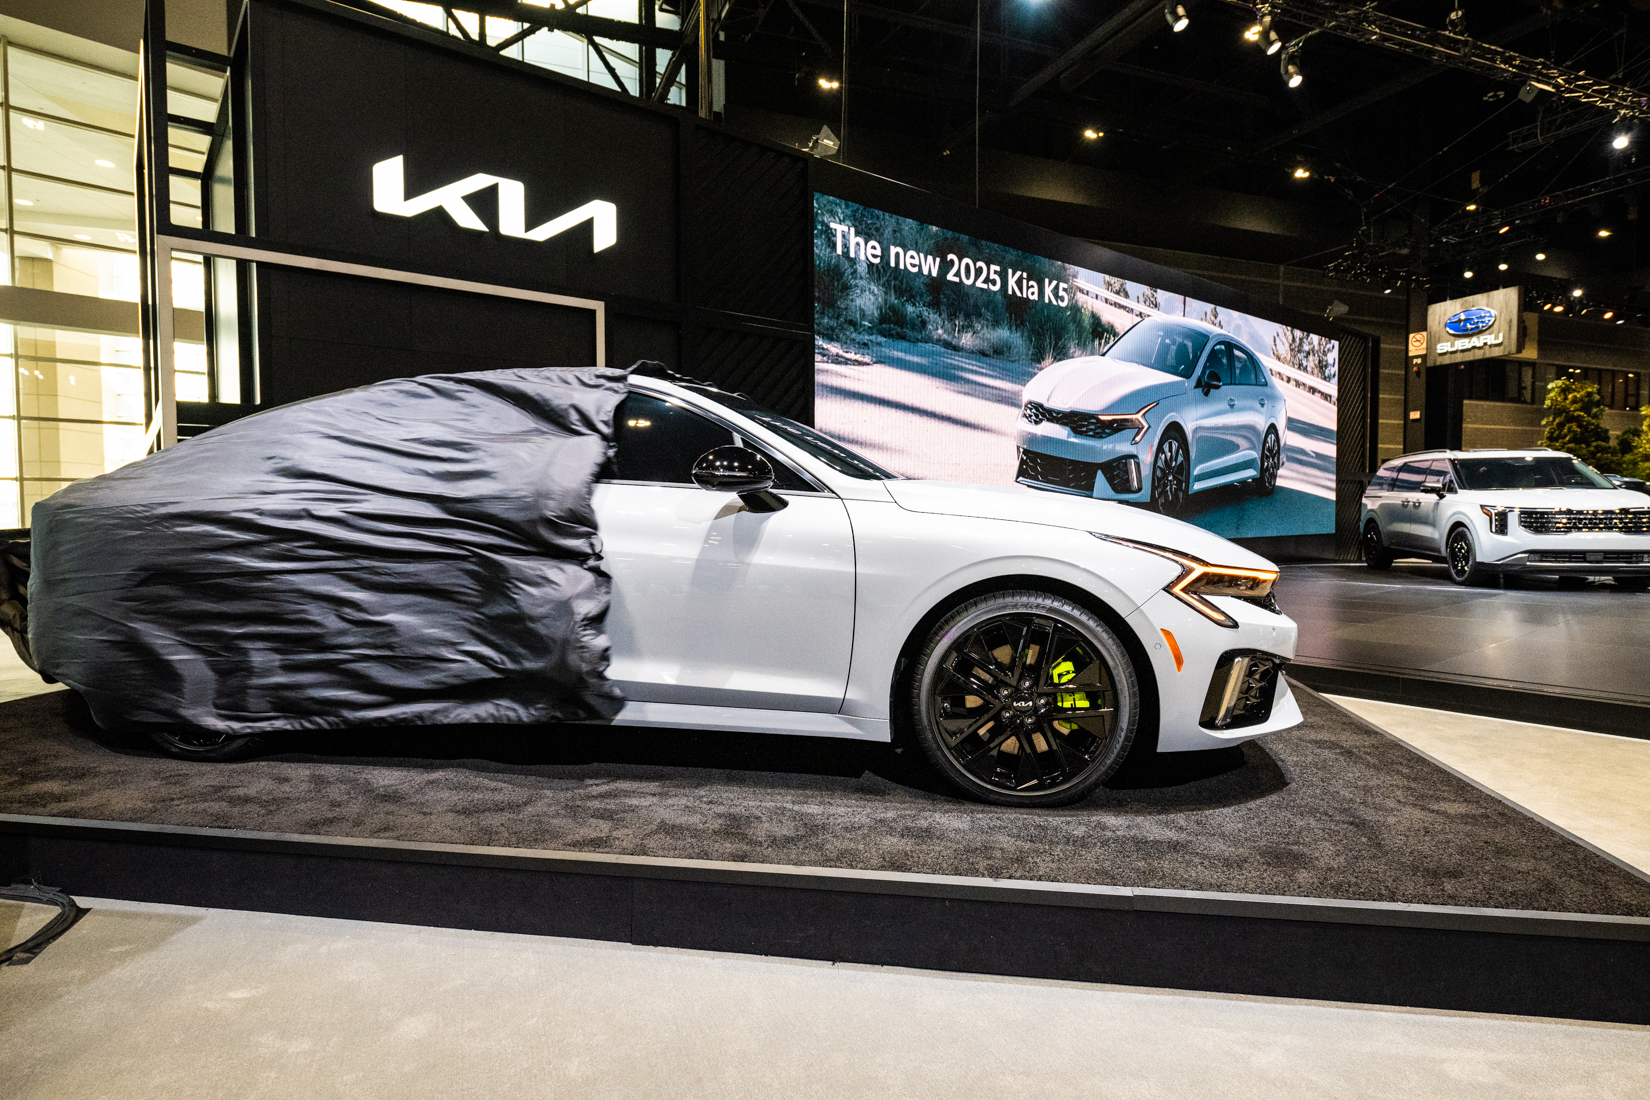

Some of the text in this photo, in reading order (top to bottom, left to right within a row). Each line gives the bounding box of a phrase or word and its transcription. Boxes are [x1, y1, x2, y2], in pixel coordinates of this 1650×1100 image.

[829, 221, 1069, 308] The new 2025 Kia K5
[1436, 332, 1503, 354] SUBARU
